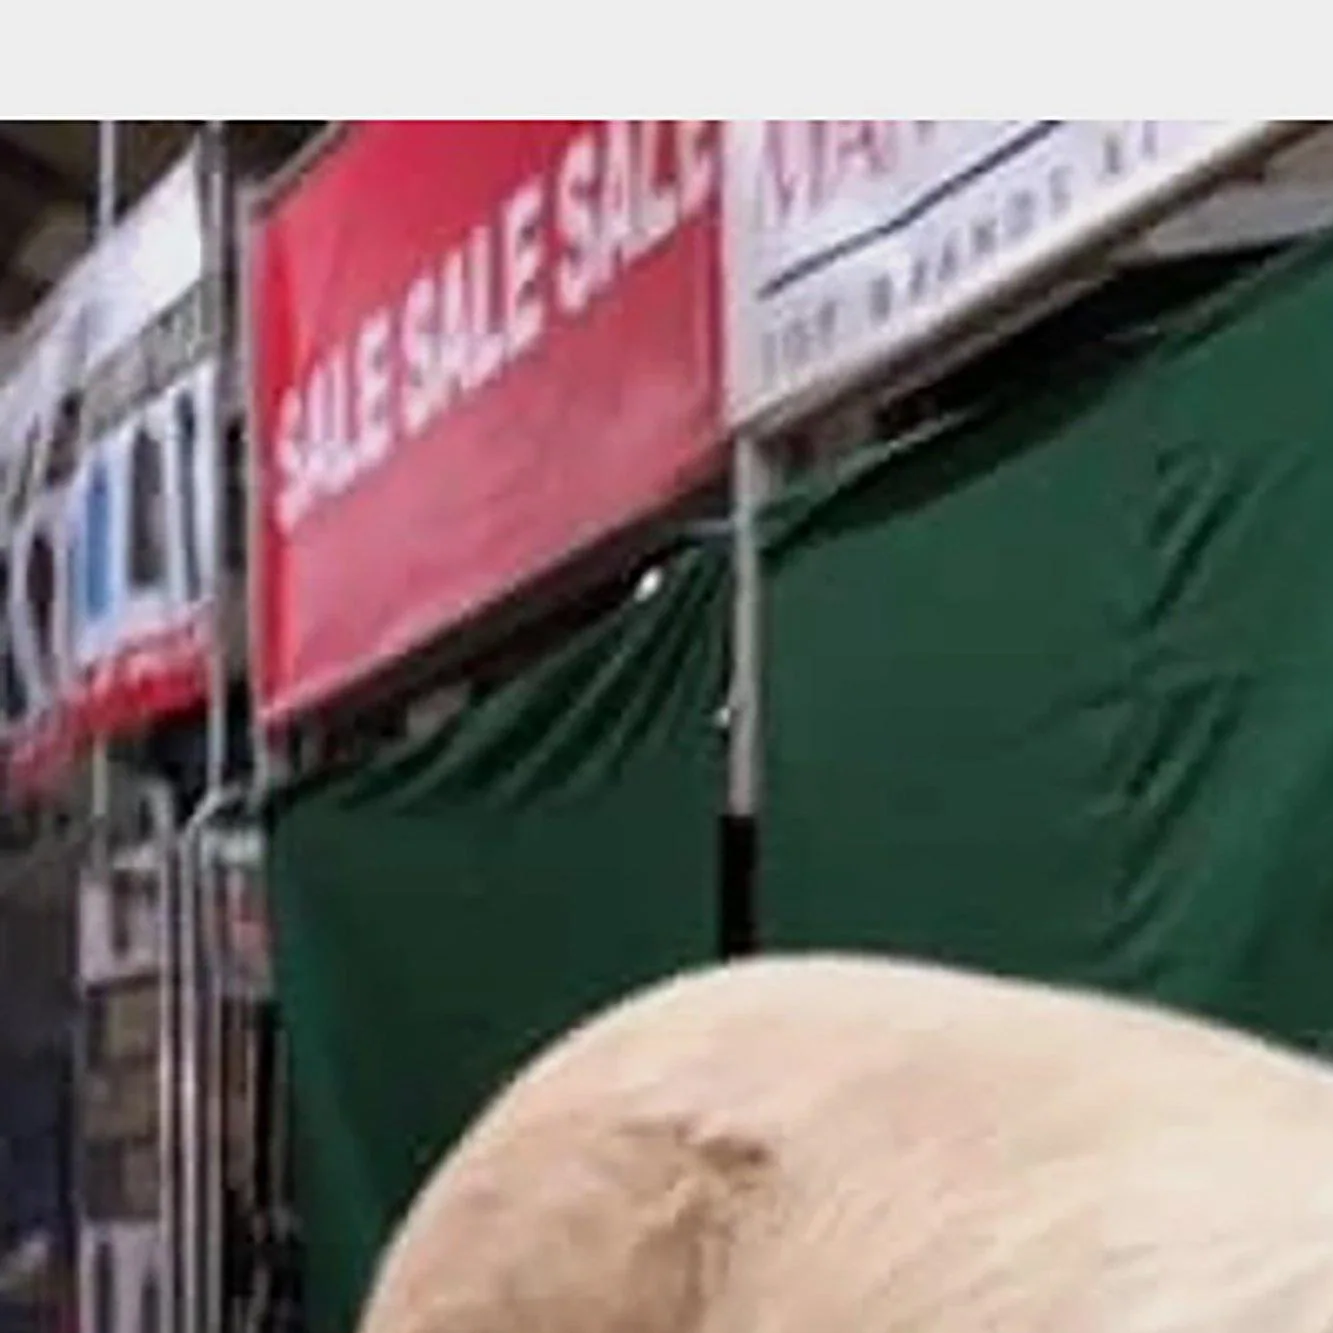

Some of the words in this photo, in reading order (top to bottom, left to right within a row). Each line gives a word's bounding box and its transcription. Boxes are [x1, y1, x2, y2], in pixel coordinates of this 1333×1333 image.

[276, 308, 394, 533] SALE
[404, 264, 546, 435] SALE
[556, 119, 716, 314] SALE
